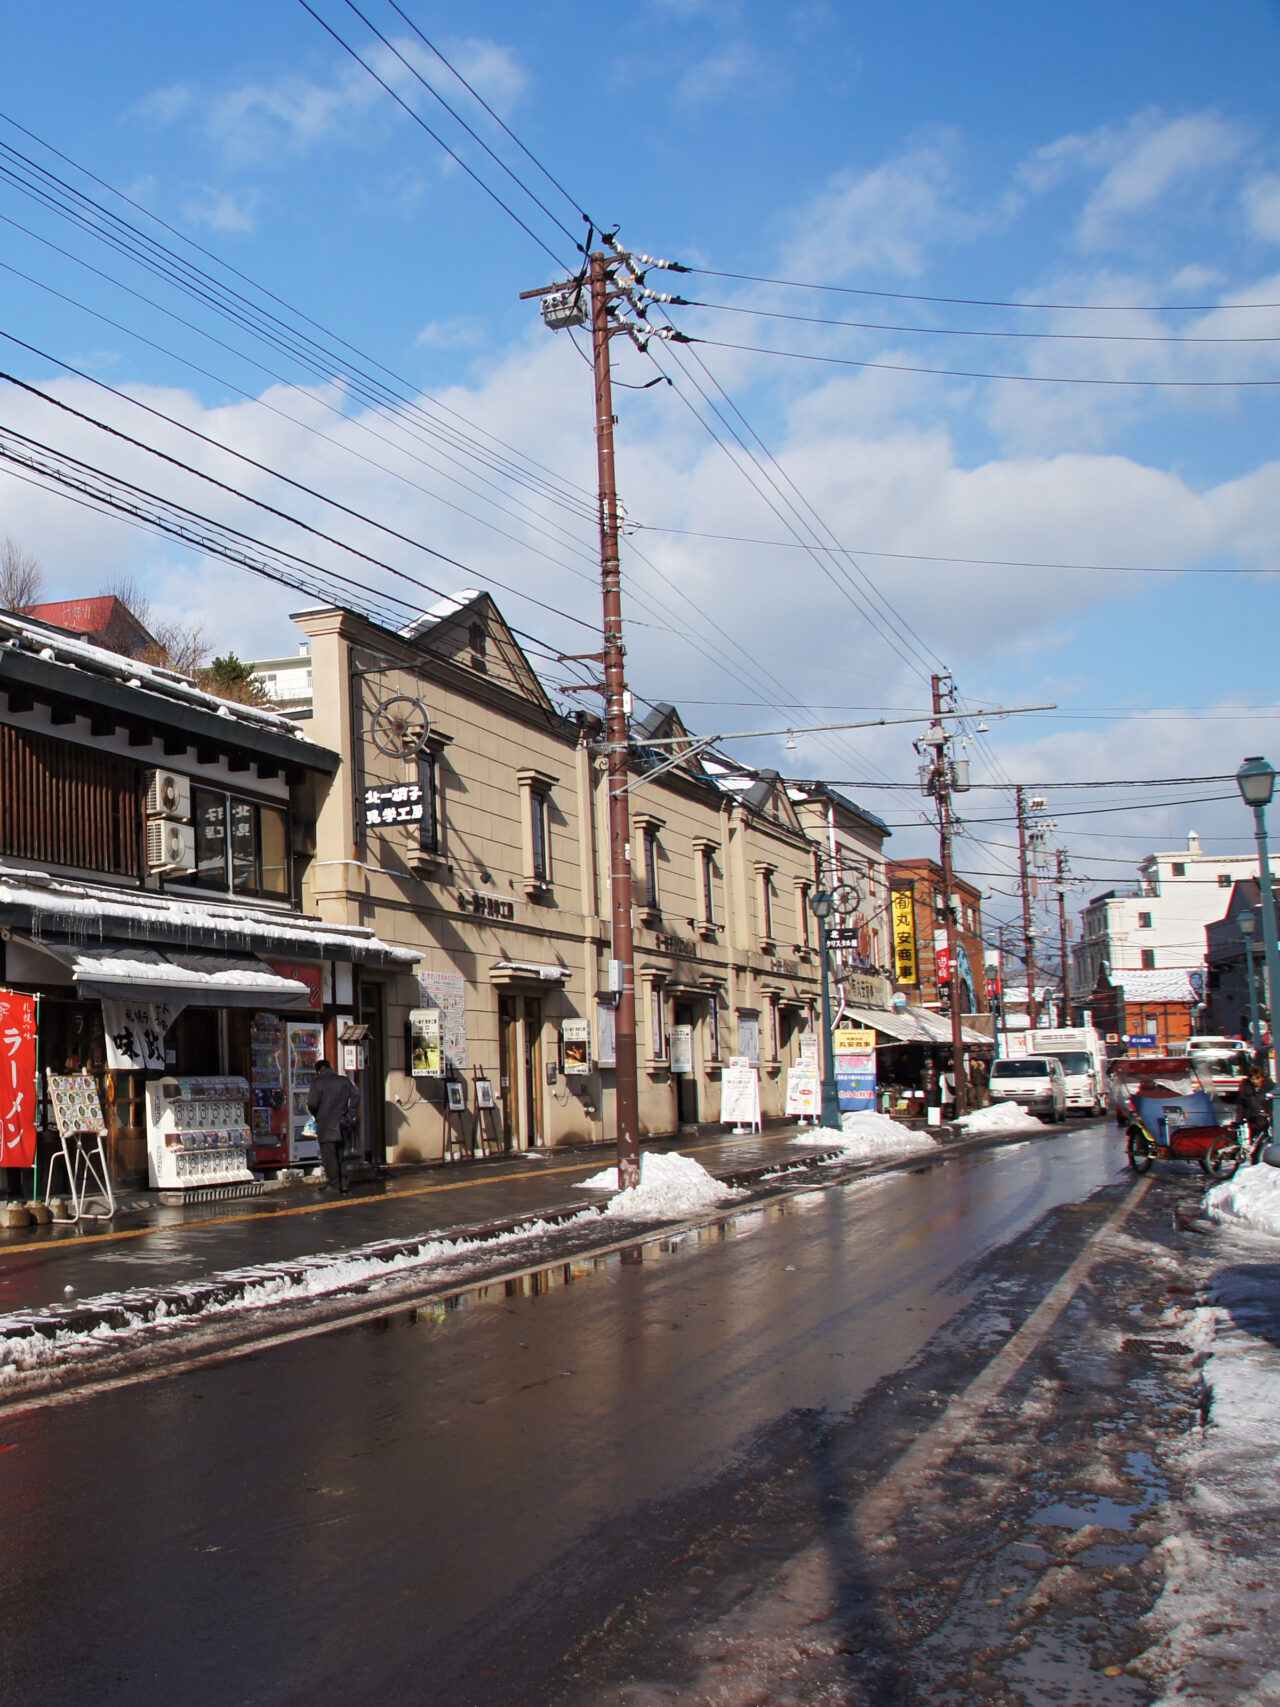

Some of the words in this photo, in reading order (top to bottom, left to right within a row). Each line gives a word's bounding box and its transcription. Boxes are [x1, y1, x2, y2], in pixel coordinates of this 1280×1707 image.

[365, 786, 423, 804] 北一硝子
[365, 805, 424, 825] 見学工房
[3, 1028, 24, 1149] ラーメン
